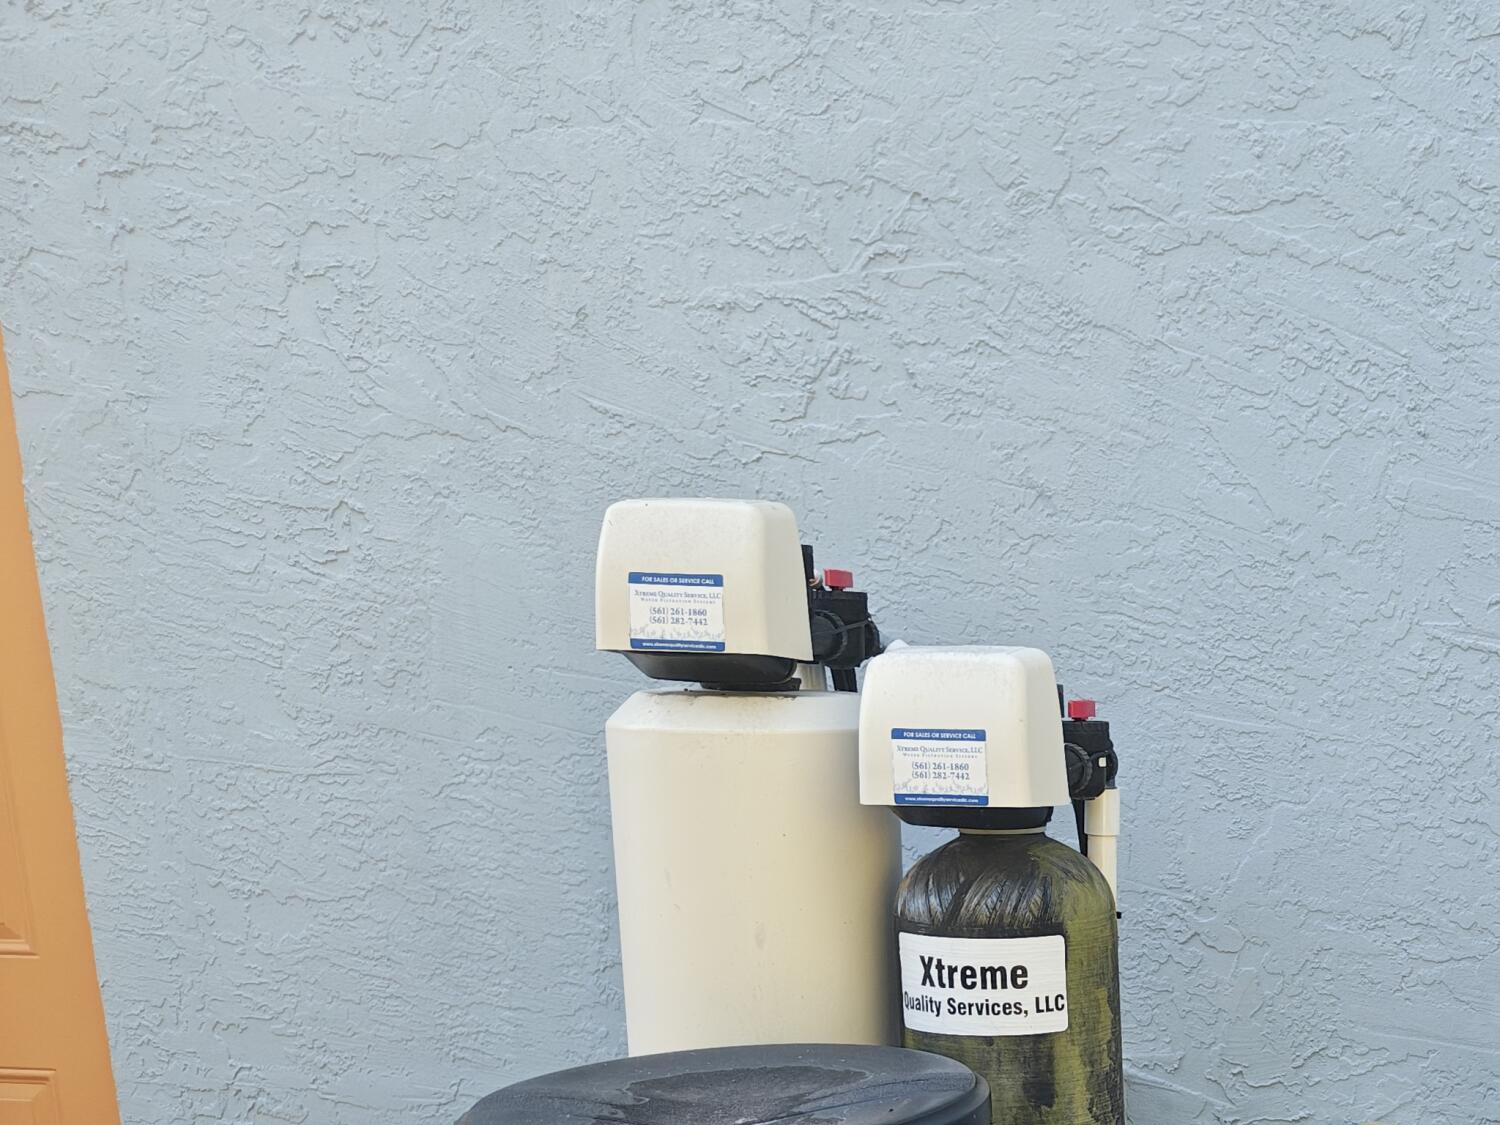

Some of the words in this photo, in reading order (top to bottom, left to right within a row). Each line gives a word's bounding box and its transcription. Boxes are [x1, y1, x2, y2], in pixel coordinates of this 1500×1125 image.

[650, 607, 668, 615] (561)
[670, 608, 707, 616] 261-1860
[650, 616, 668, 624] (561)
[670, 617, 708, 625] 282-7442
[912, 762, 930, 770] (561)
[933, 763, 969, 771] 261-1860
[912, 771, 930, 779] (561)
[933, 772, 970, 780] 282-7442
[919, 955, 1029, 990] Xtreme
[904, 991, 942, 1018] Quality
[947, 997, 1028, 1018] Services,
[1035, 994, 1065, 1014] LLC
